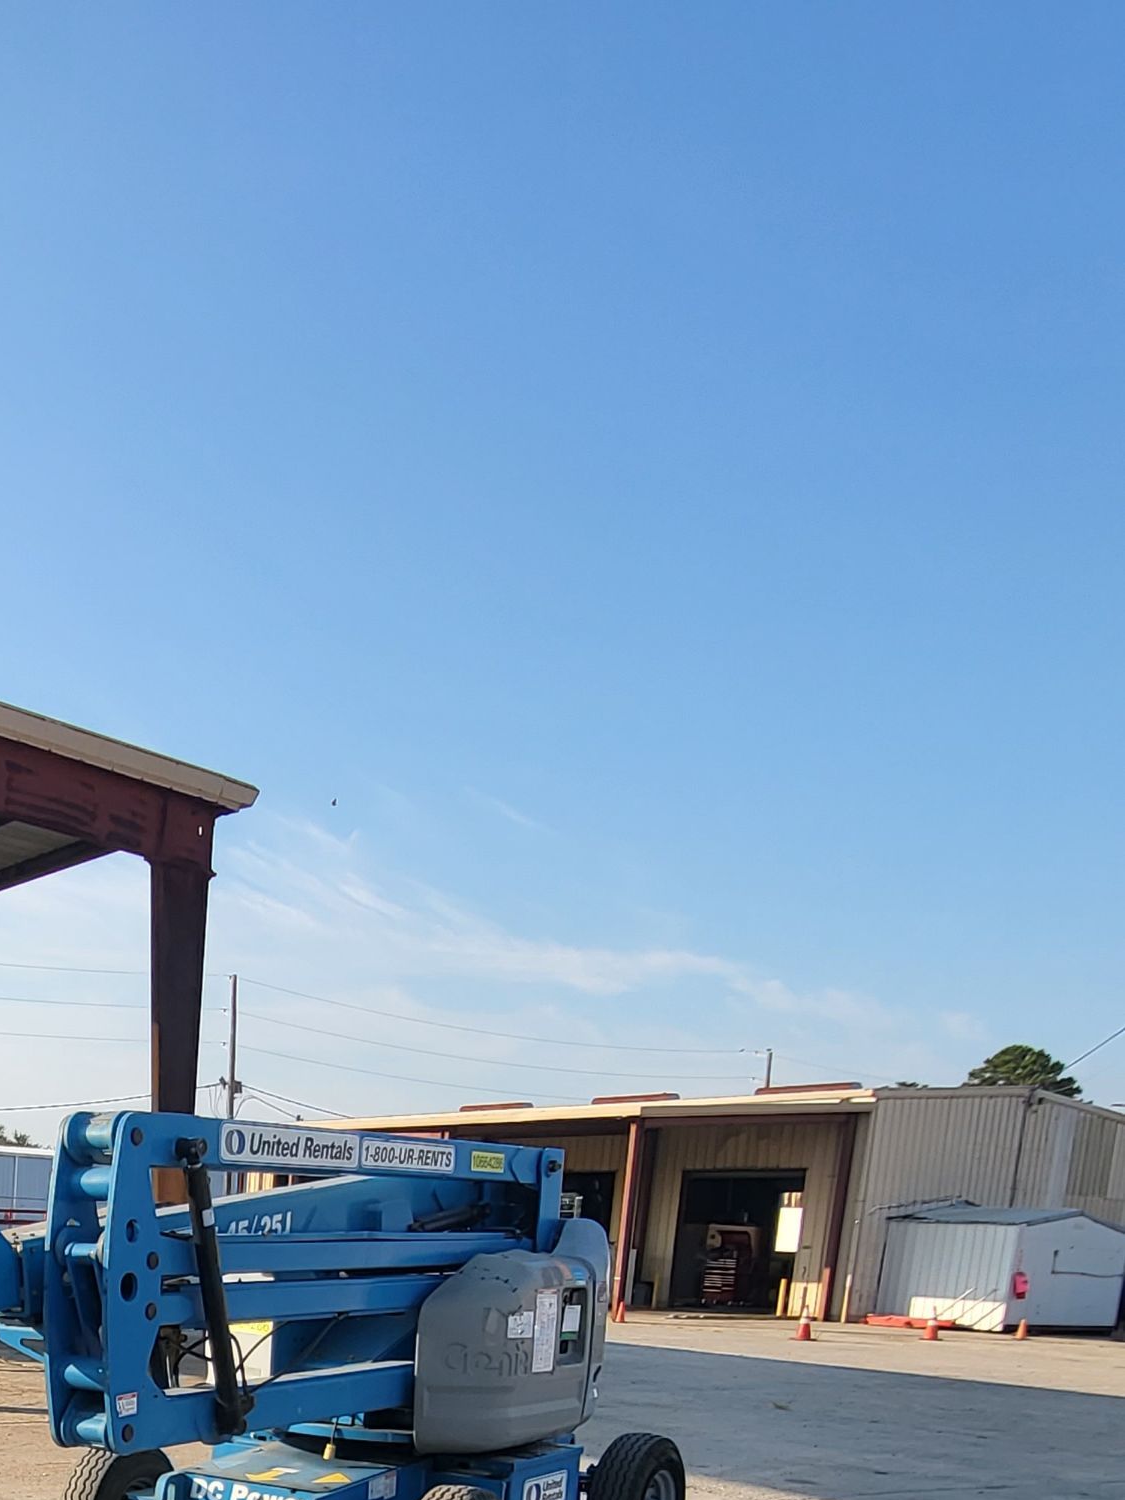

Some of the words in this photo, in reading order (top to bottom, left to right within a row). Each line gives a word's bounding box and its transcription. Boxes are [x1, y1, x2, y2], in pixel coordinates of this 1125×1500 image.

[249, 1132, 301, 1158] United
[302, 1136, 355, 1161] Rentals
[364, 1145, 453, 1168] 1-800-UR-RENTS
[543, 1476, 564, 1491] United
